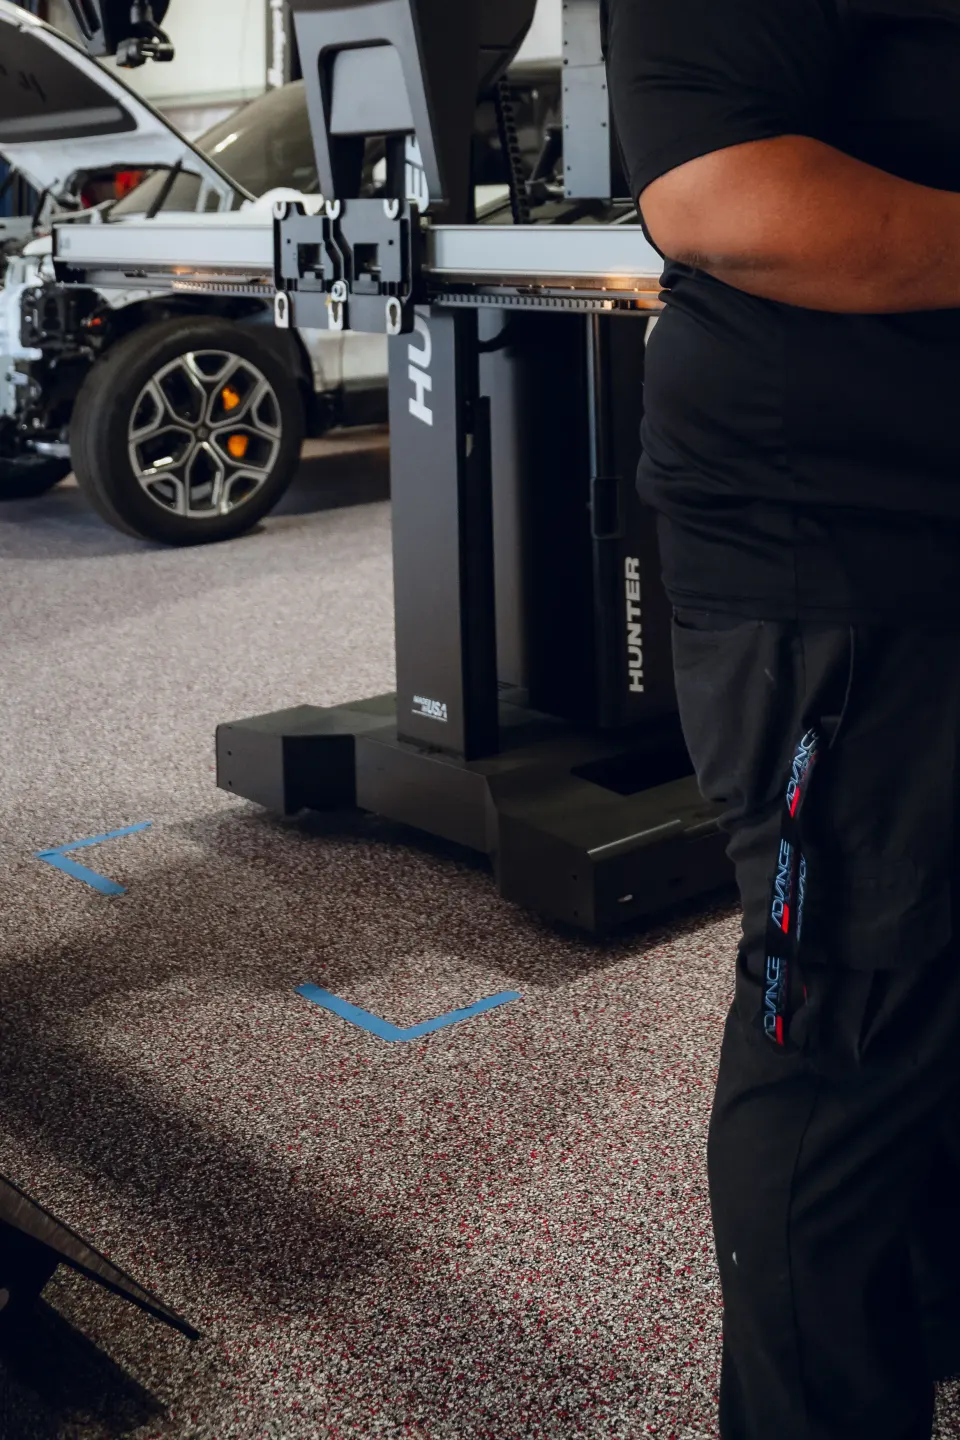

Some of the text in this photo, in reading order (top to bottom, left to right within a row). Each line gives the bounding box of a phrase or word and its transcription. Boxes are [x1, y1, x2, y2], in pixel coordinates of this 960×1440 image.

[624, 556, 644, 692] HUNTER
[772, 839, 790, 928] ADVANCE
[764, 955, 780, 1042] ADVANCE
